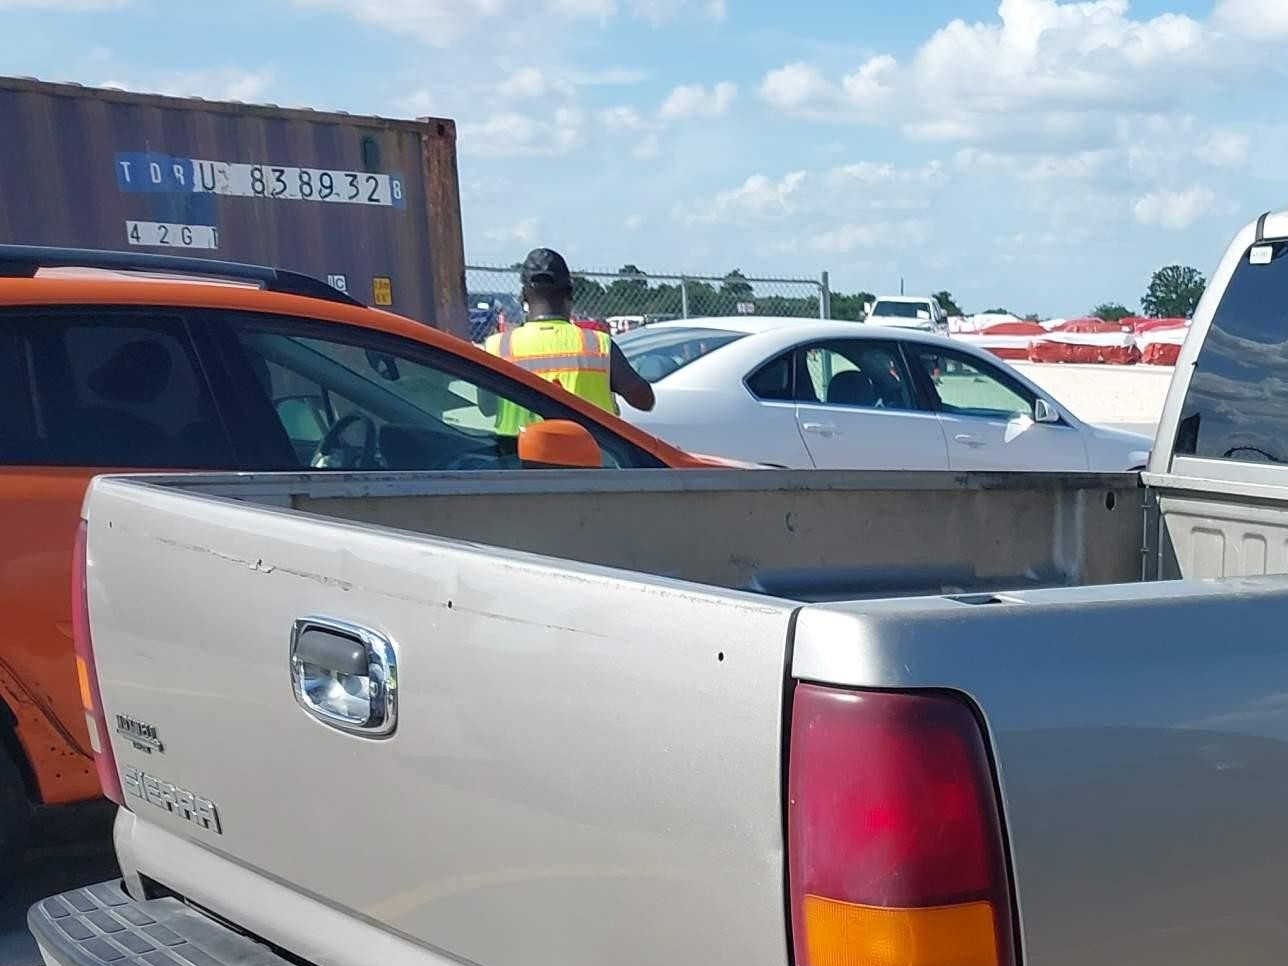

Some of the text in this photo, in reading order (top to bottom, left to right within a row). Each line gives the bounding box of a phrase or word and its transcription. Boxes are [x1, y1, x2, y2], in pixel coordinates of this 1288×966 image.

[250, 167, 381, 203] 838932
[392, 179, 403, 200] 8
[124, 767, 223, 835] SIERRA
